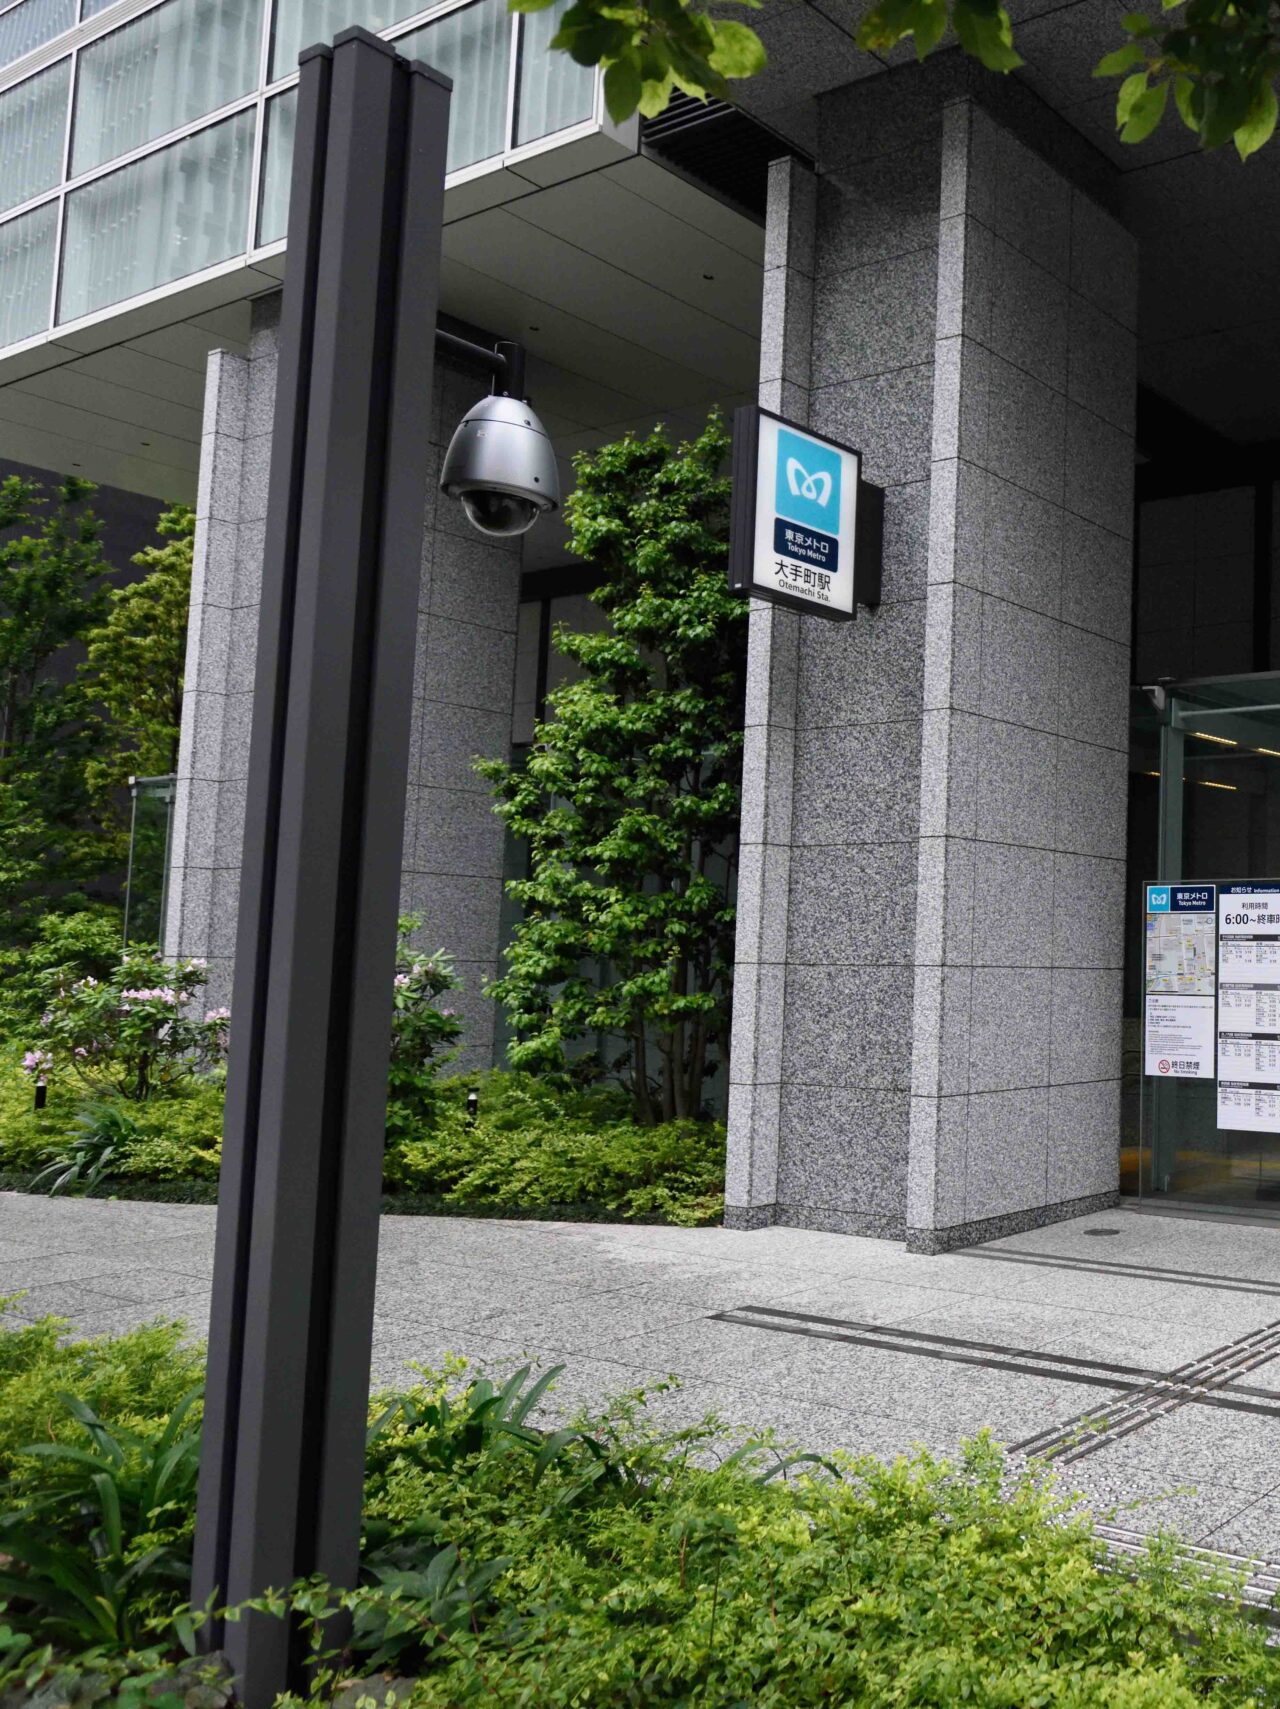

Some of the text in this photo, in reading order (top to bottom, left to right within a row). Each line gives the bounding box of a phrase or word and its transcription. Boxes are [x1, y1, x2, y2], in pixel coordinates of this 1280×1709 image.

[785, 529, 829, 553] 東京メトロ
[788, 543, 826, 562] Tokyo Metro
[775, 560, 831, 592] 大手町駅
[779, 579, 830, 602] Otemachi Sta.
[1176, 892, 1208, 900] 東京メトロ
[1230, 886, 1252, 894] お知らせ
[1241, 902, 1269, 910] 利用時間
[1171, 1060, 1200, 1070] 終日禁煙
